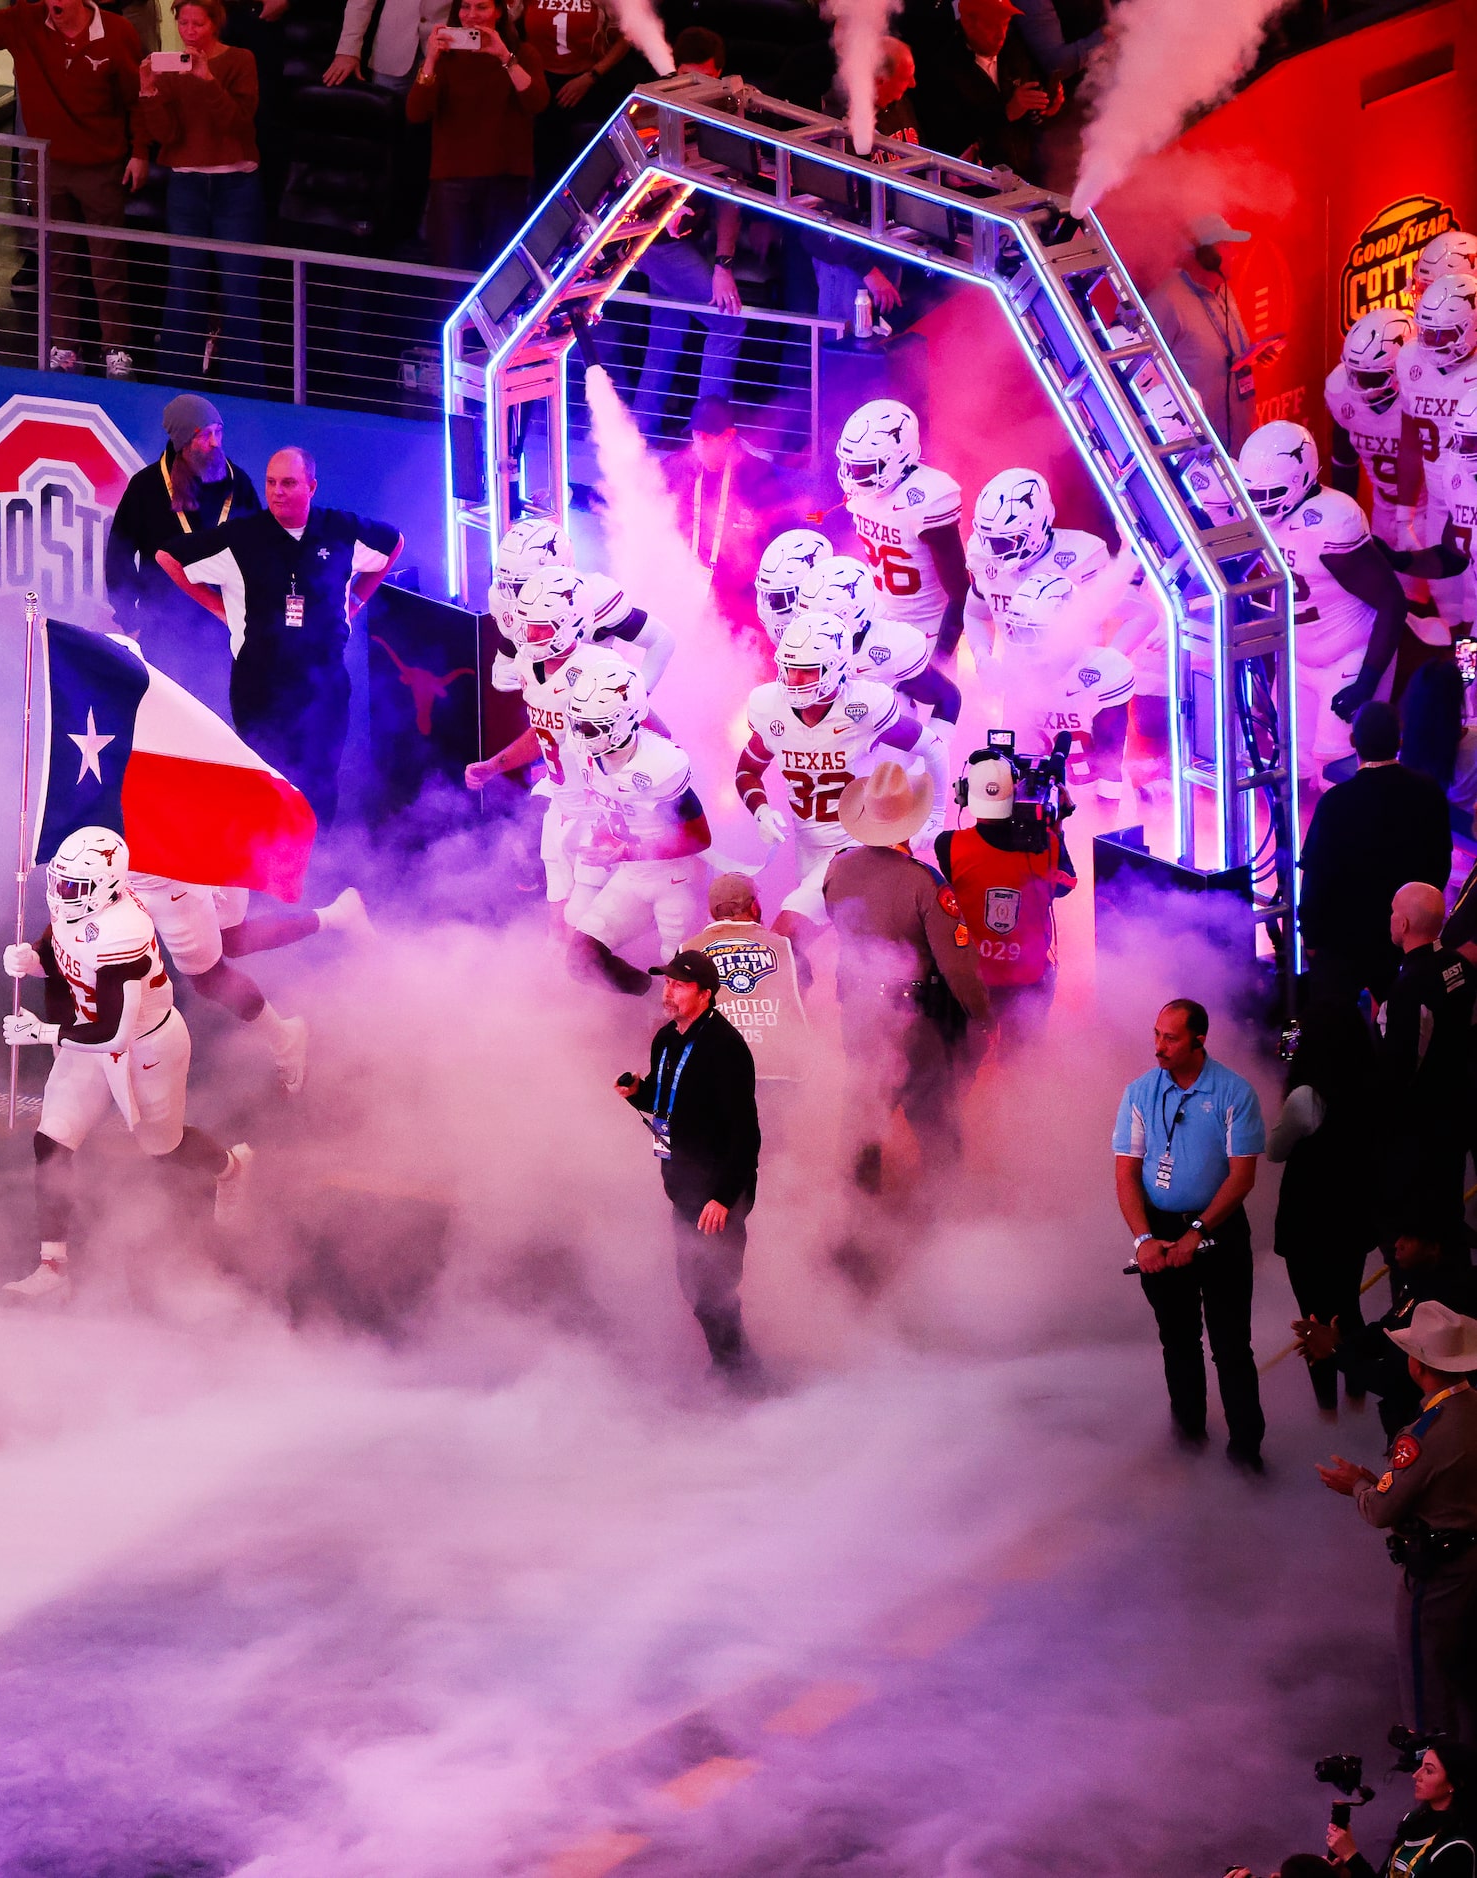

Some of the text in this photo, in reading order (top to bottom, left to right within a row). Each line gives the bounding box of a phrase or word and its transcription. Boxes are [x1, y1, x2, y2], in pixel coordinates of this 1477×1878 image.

[538, 0, 591, 13] TEXAS
[552, 12, 571, 55] 1
[1352, 212, 1450, 267] GOODYEAR
[1350, 248, 1425, 322] COTT
[1415, 396, 1459, 418] TEXA
[856, 514, 902, 545] TEXAS
[1042, 712, 1081, 729] XAS
[782, 749, 846, 770] TEXAS
[782, 769, 856, 823] 32
[712, 952, 773, 969] OTTON
[979, 939, 1021, 961] 029
[742, 1028, 764, 1044] 05
